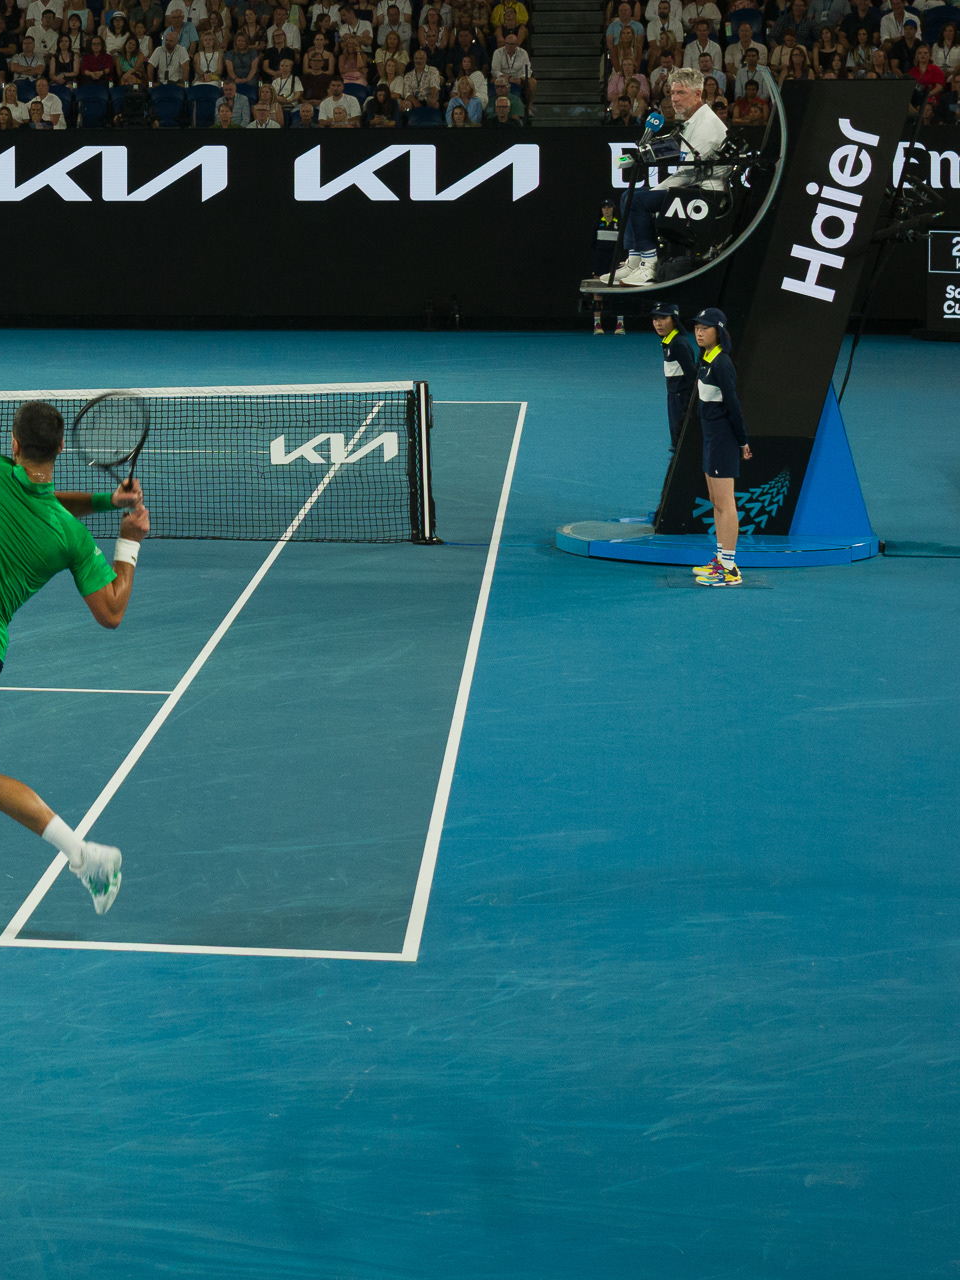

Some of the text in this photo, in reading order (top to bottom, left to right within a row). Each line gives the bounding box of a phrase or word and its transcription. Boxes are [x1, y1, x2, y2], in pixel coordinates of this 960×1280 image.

[293, 143, 540, 202] KIA
[664, 197, 709, 221] AO
[780, 118, 880, 303] Haier
[270, 431, 399, 465] KIA
